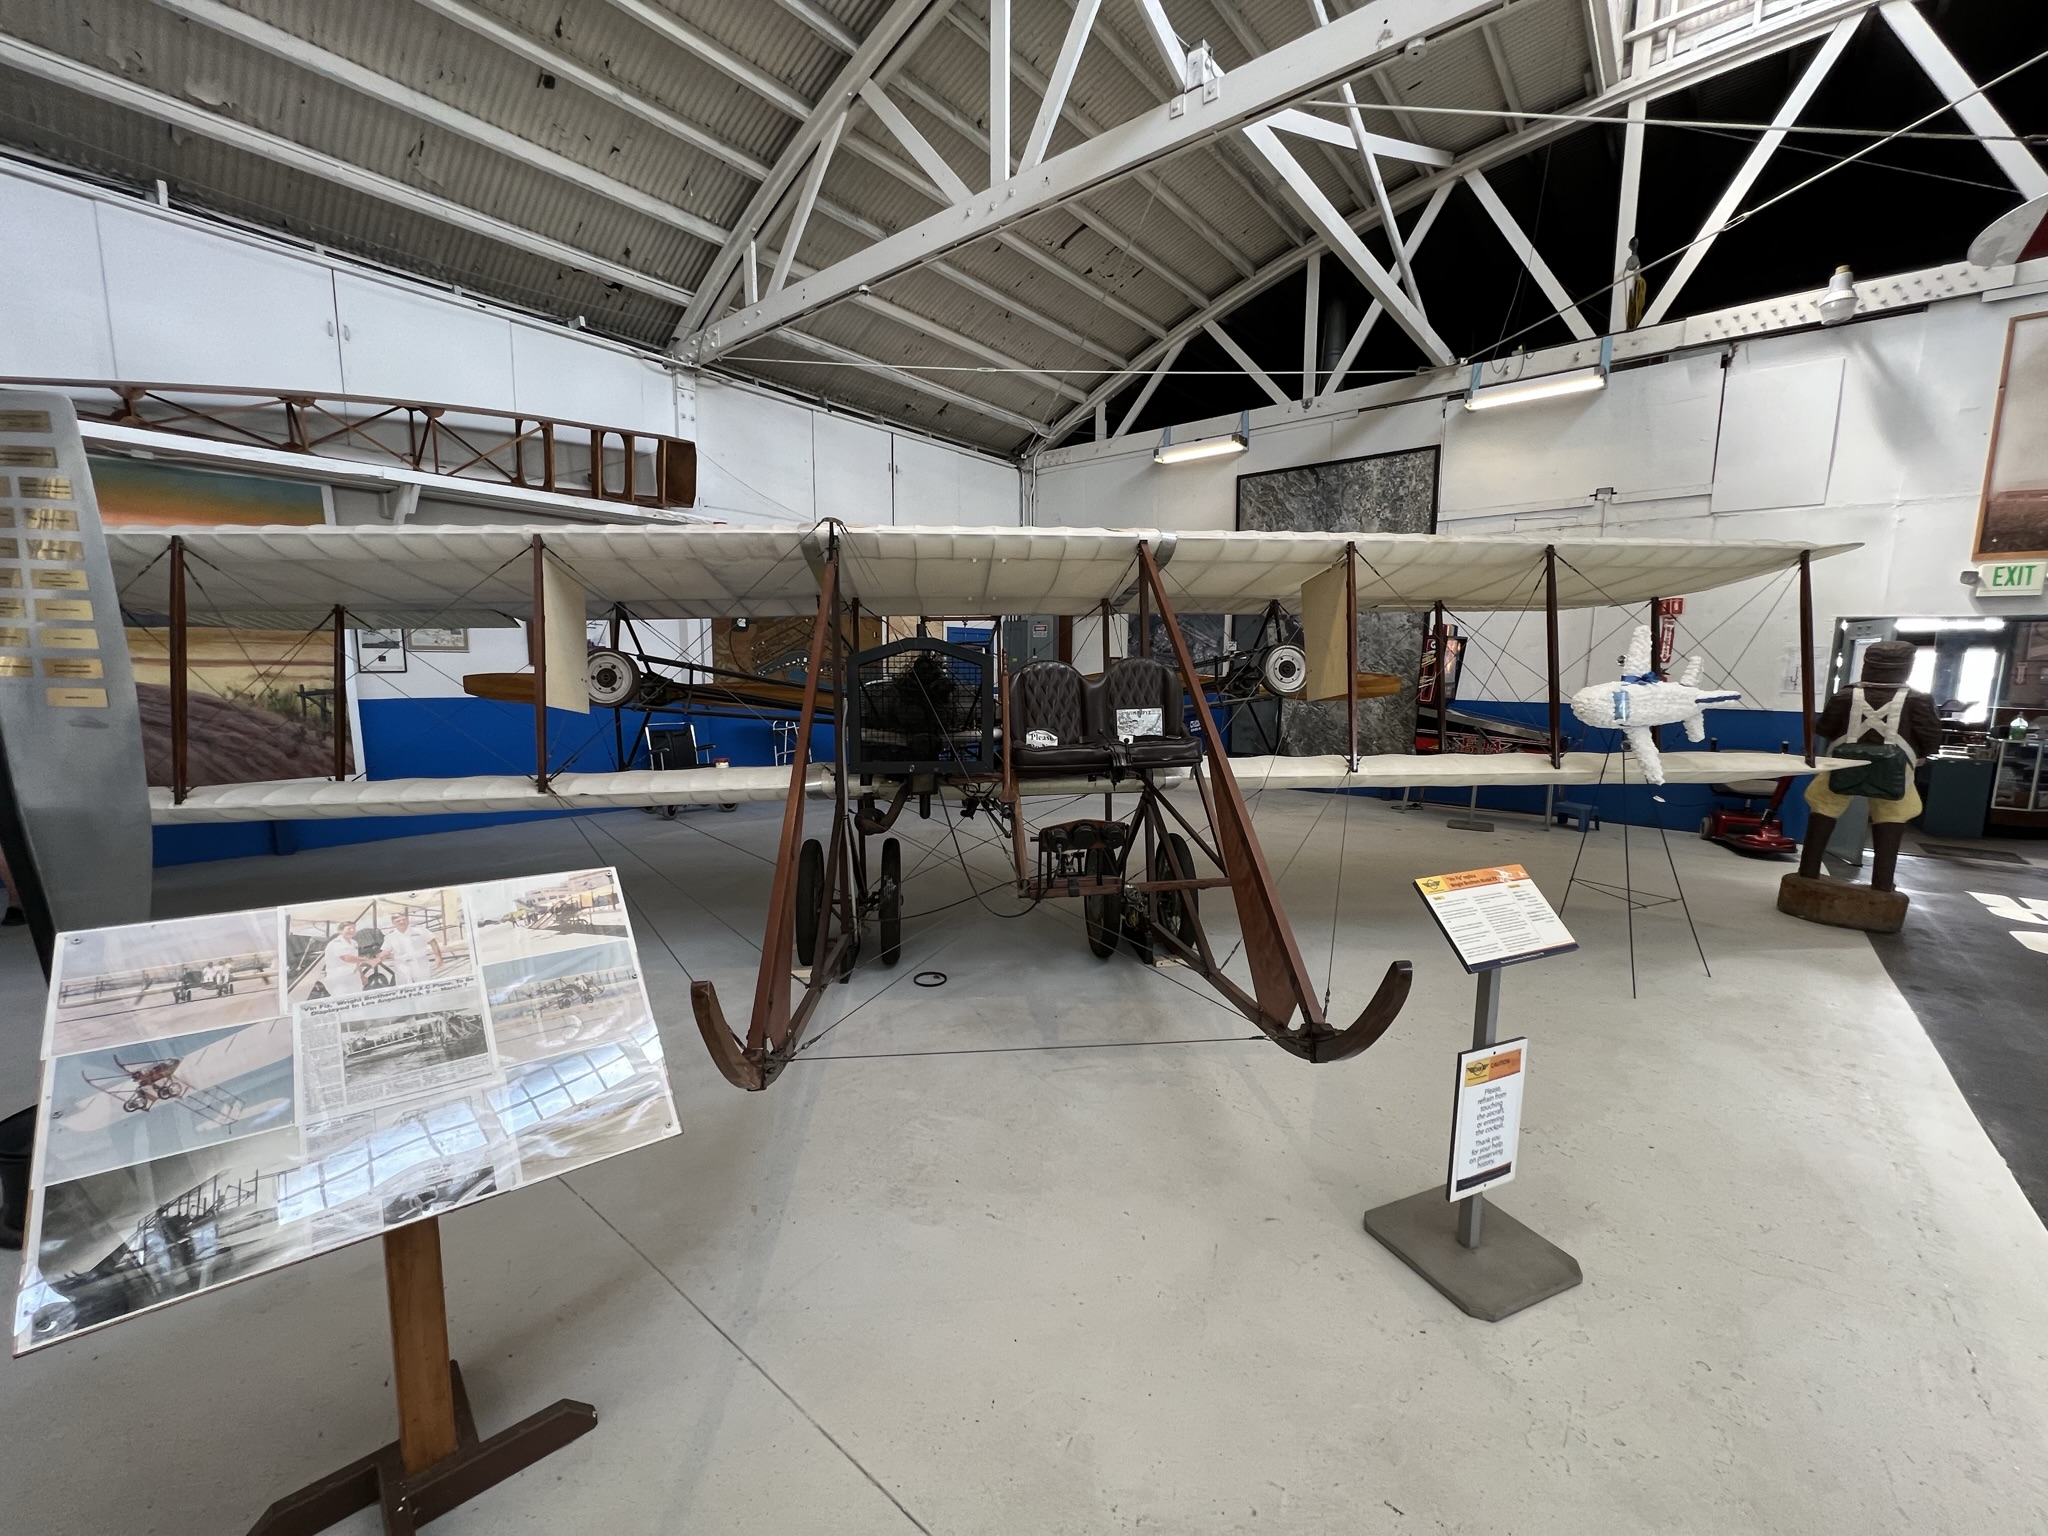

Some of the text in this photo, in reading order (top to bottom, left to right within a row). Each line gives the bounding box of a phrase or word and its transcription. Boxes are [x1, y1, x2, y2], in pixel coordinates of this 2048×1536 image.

[1992, 565, 2037, 586] EXIT
[310, 1004, 349, 1017] Displayed
[361, 999, 375, 1007] Los
[377, 994, 407, 1004] Angeles
[1477, 1092, 1507, 1104] refrain from
[1480, 1100, 1503, 1112] touching
[1484, 1115, 1504, 1126] entering
[1476, 1135, 1501, 1146] Thank you
[1479, 1145, 1491, 1155] your
[1492, 1140, 1503, 1149] help
[1477, 1148, 1504, 1162] preserving
